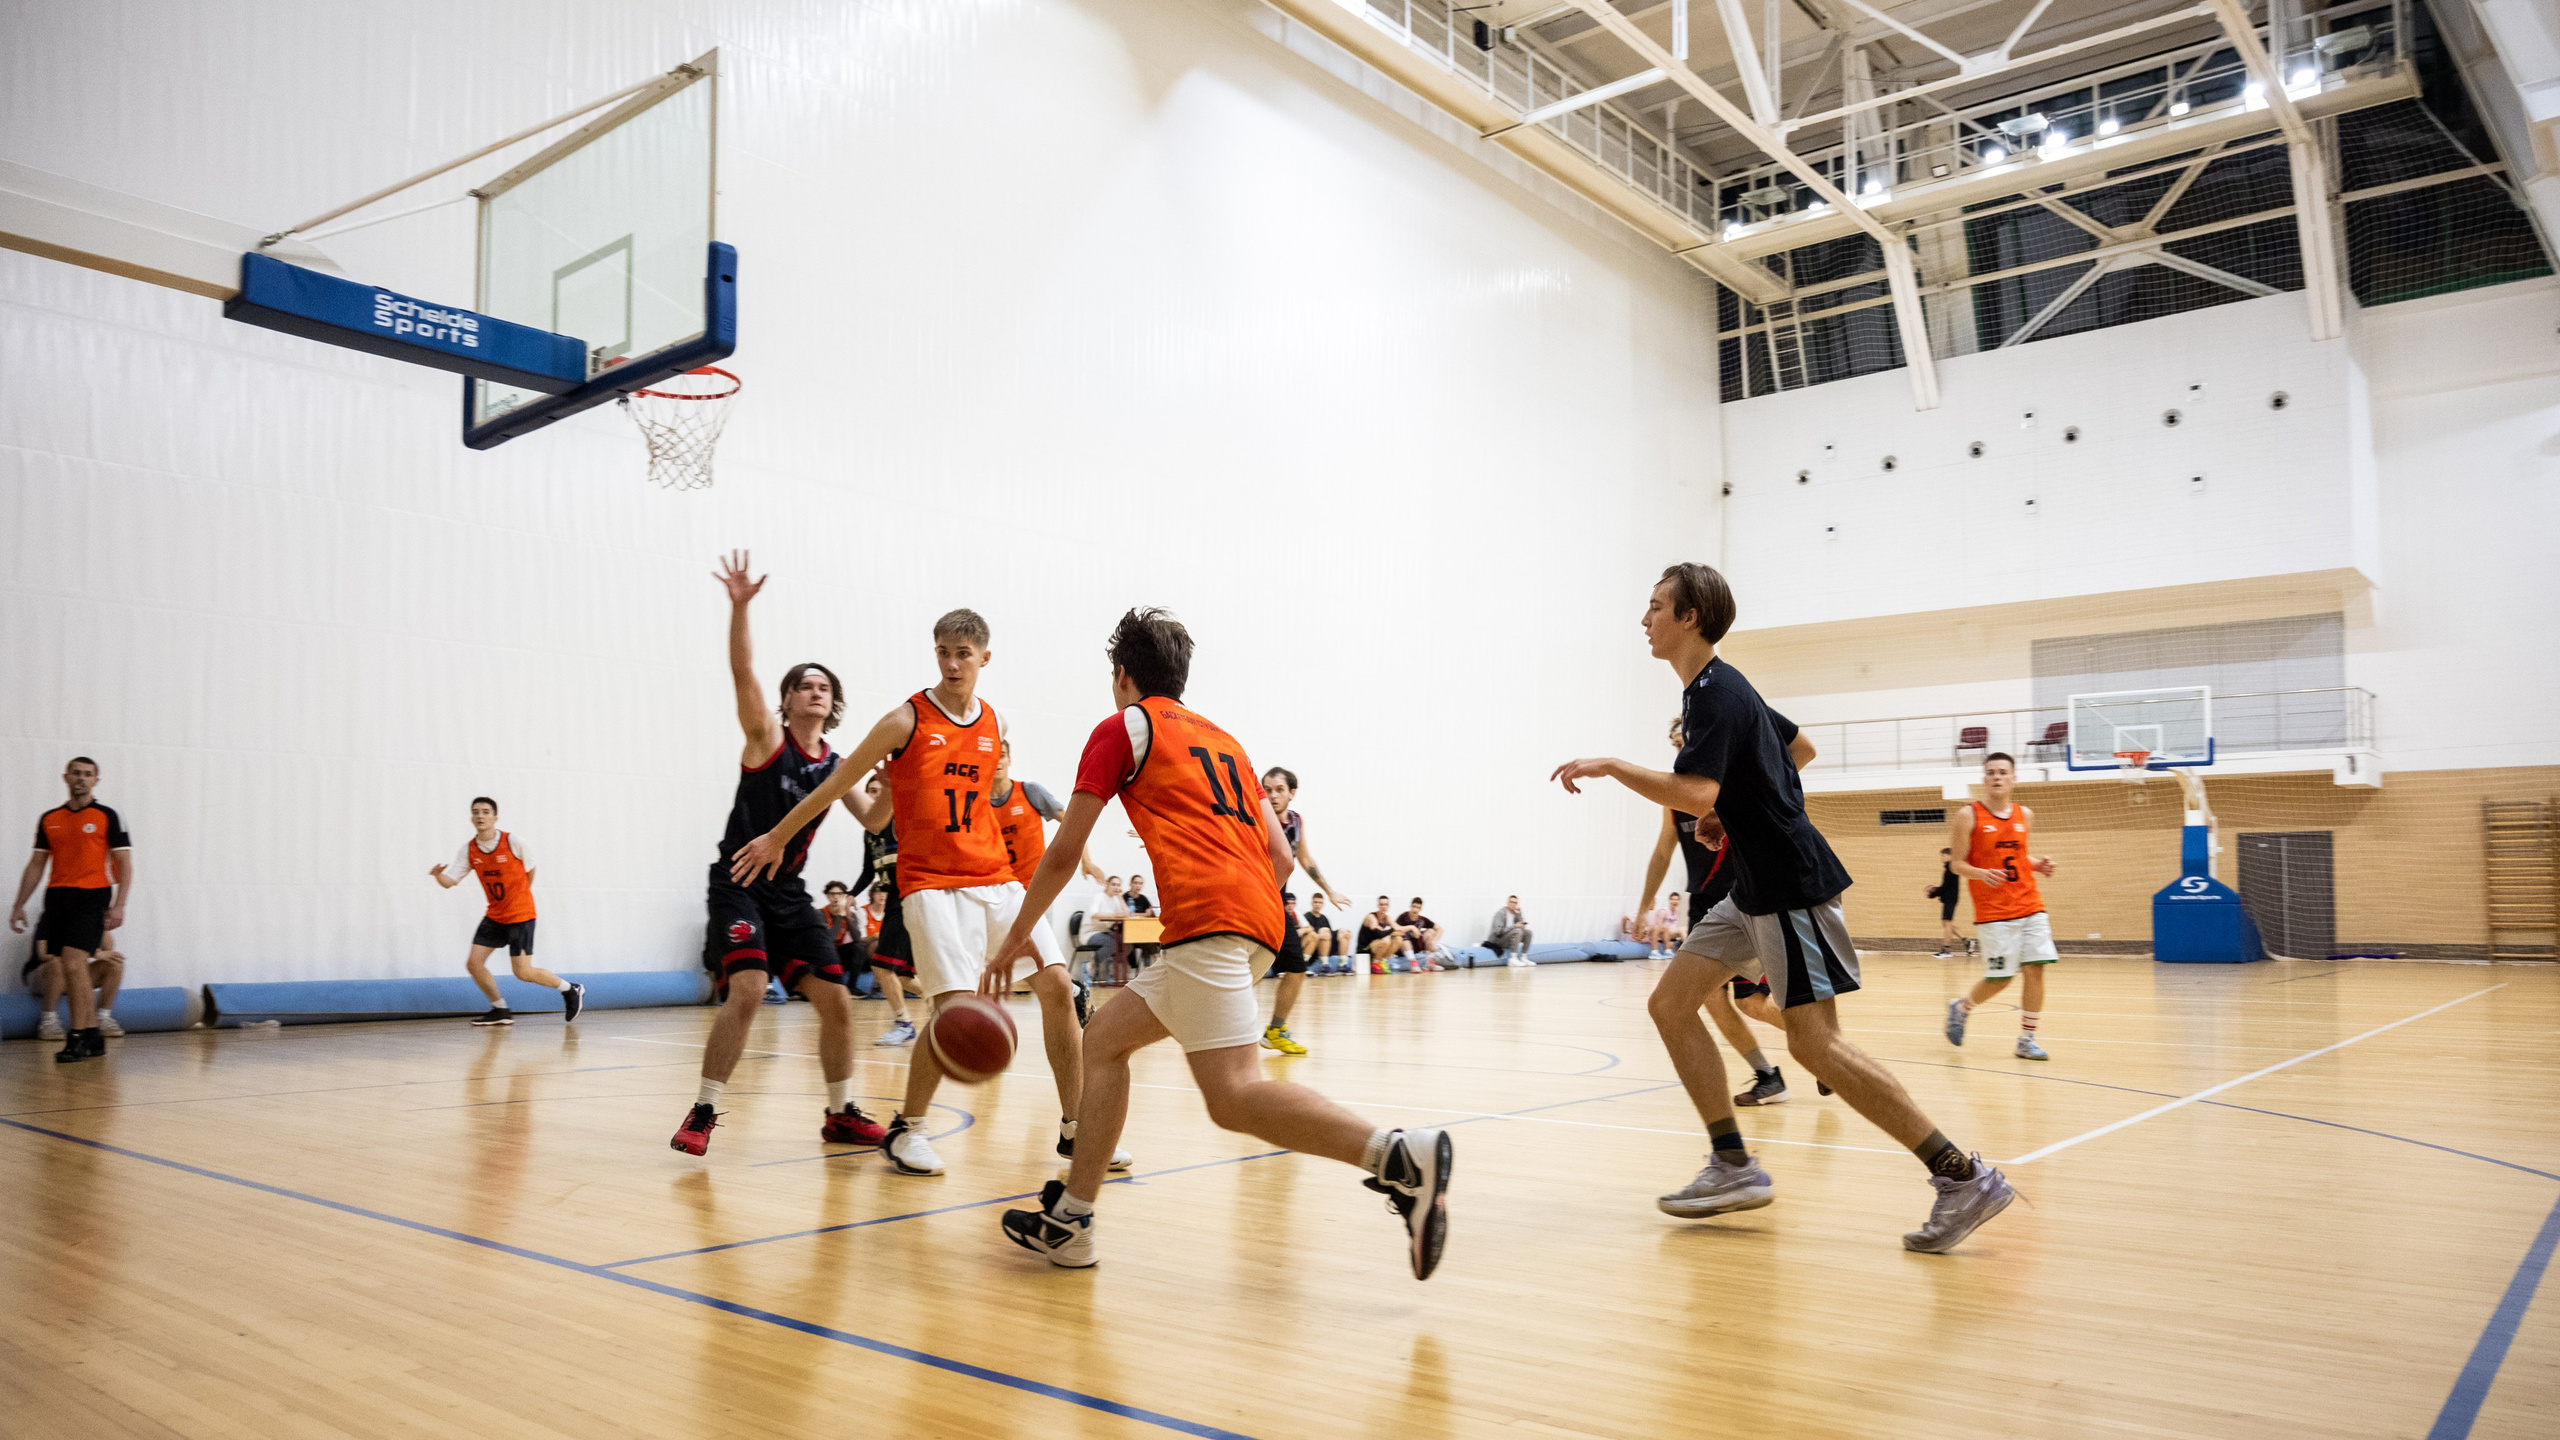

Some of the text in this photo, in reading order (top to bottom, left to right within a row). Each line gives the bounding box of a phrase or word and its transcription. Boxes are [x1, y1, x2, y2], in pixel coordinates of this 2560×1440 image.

[374, 294, 479, 332] Schelde
[374, 310, 479, 348] Sports
[1188, 747, 1256, 826] 11
[944, 788, 979, 833] 14
[486, 882, 505, 901] 10
